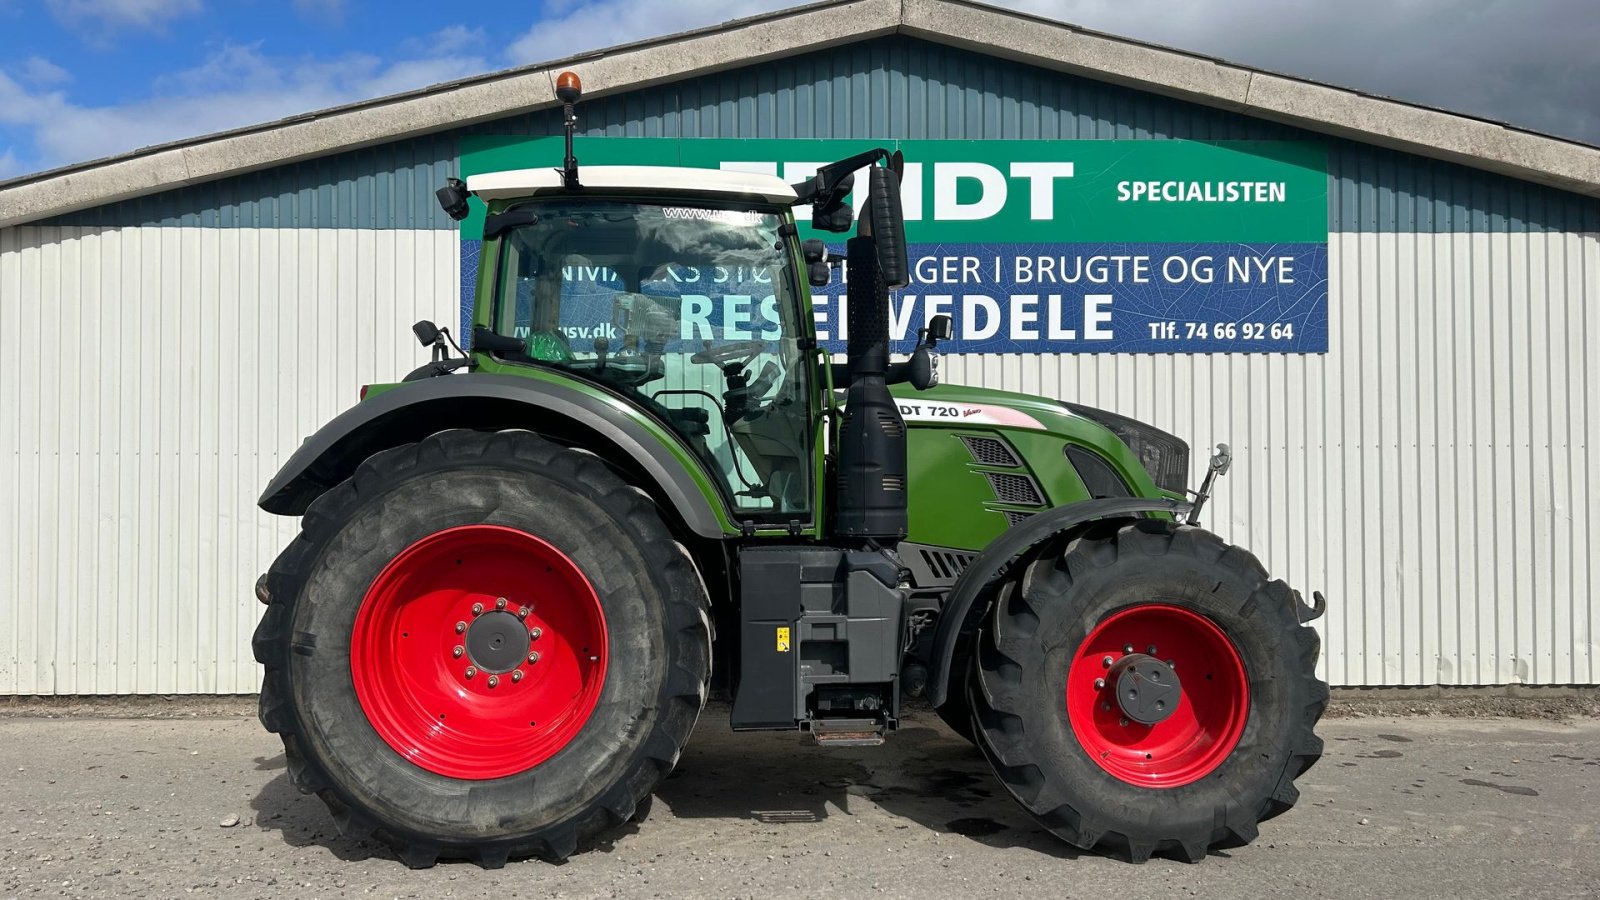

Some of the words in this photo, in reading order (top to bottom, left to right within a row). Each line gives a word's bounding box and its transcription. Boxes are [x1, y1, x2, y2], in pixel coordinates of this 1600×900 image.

[1117, 180, 1286, 202] SPECIALISTEN
[995, 256, 1001, 283] I
[1015, 256, 1150, 284] BRUGTE
[1162, 256, 1213, 284] OG
[1228, 256, 1294, 283] NYE
[1148, 322, 1180, 340] Tlf.
[1185, 322, 1208, 339] 74
[1213, 322, 1237, 340] 66
[1242, 322, 1265, 340] 92
[1270, 322, 1294, 340] 64
[928, 406, 959, 417] 720
